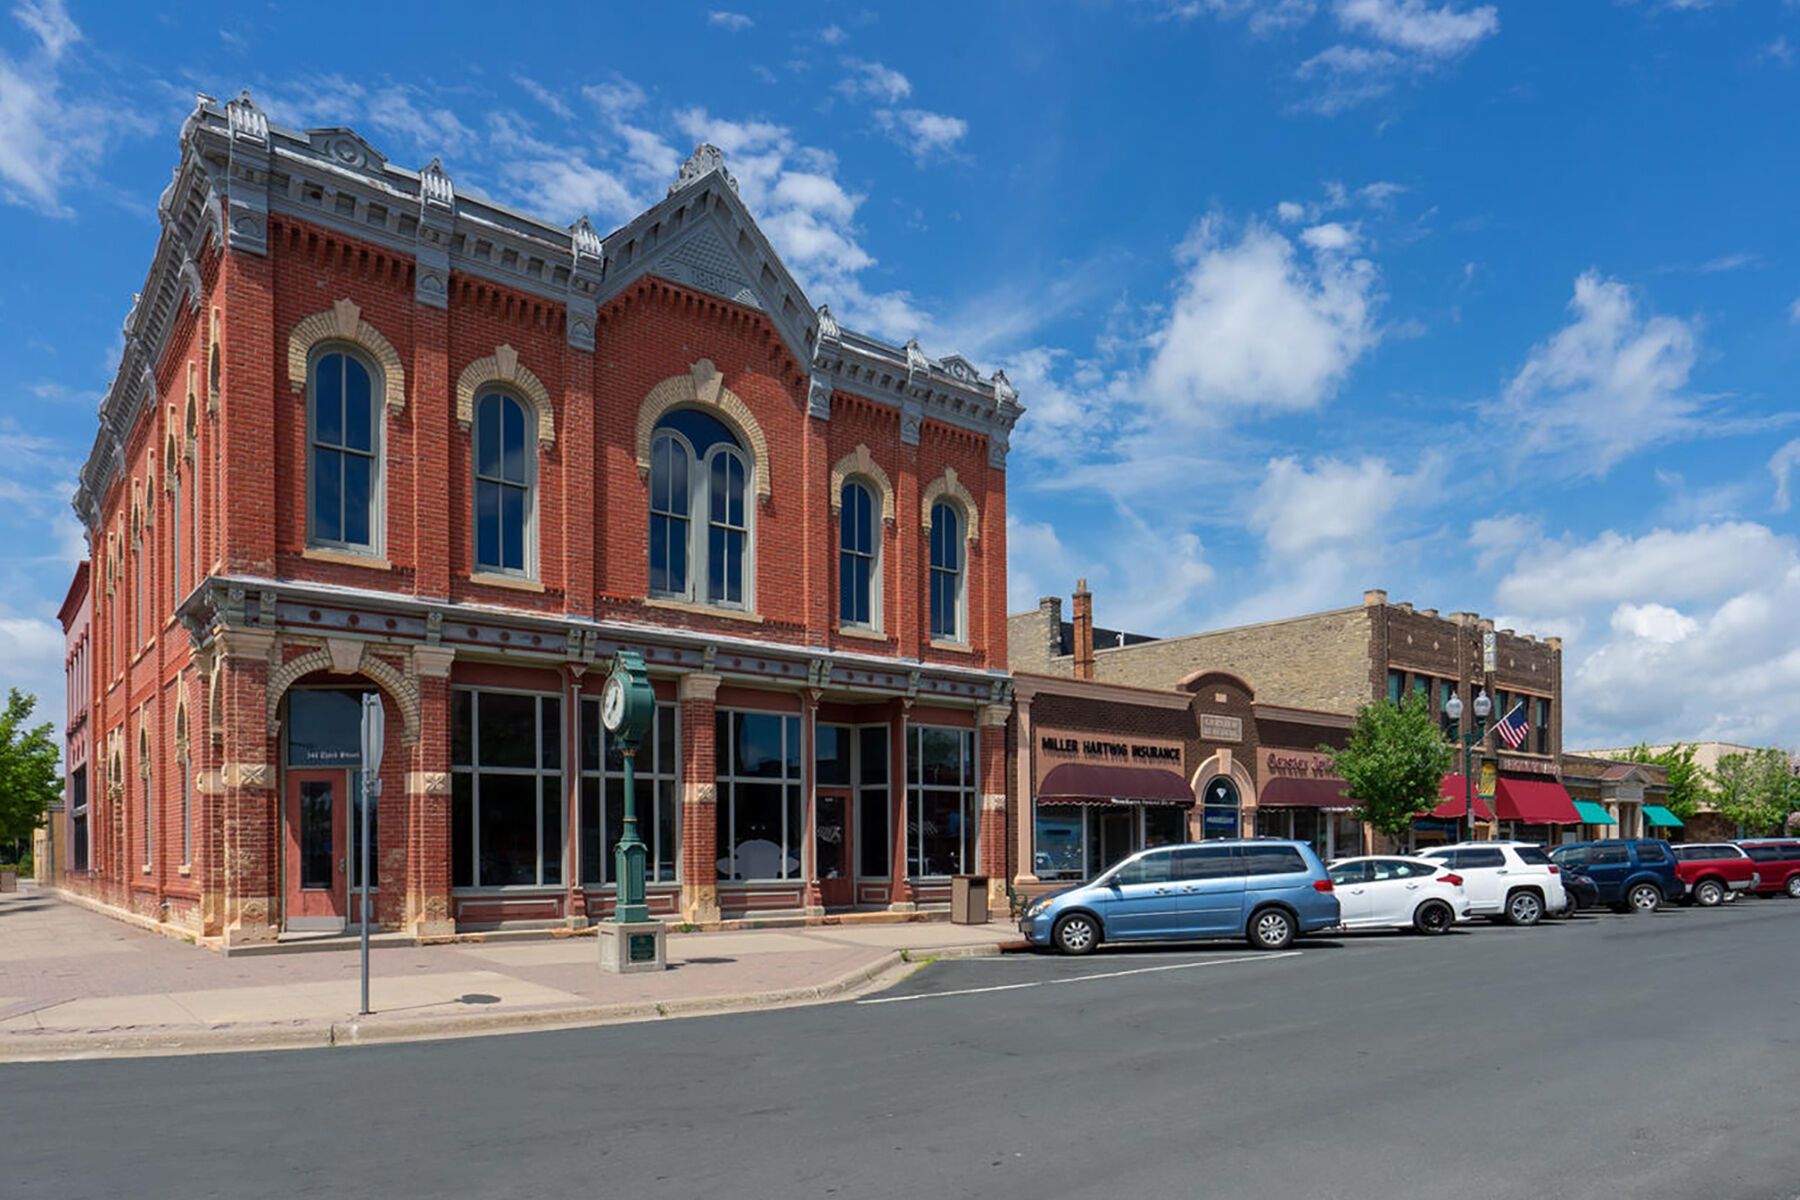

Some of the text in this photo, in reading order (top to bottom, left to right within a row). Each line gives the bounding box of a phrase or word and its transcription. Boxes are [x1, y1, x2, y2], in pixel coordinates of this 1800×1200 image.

[1042, 736, 1181, 761] MILLER HARTWIG INSURANCE
